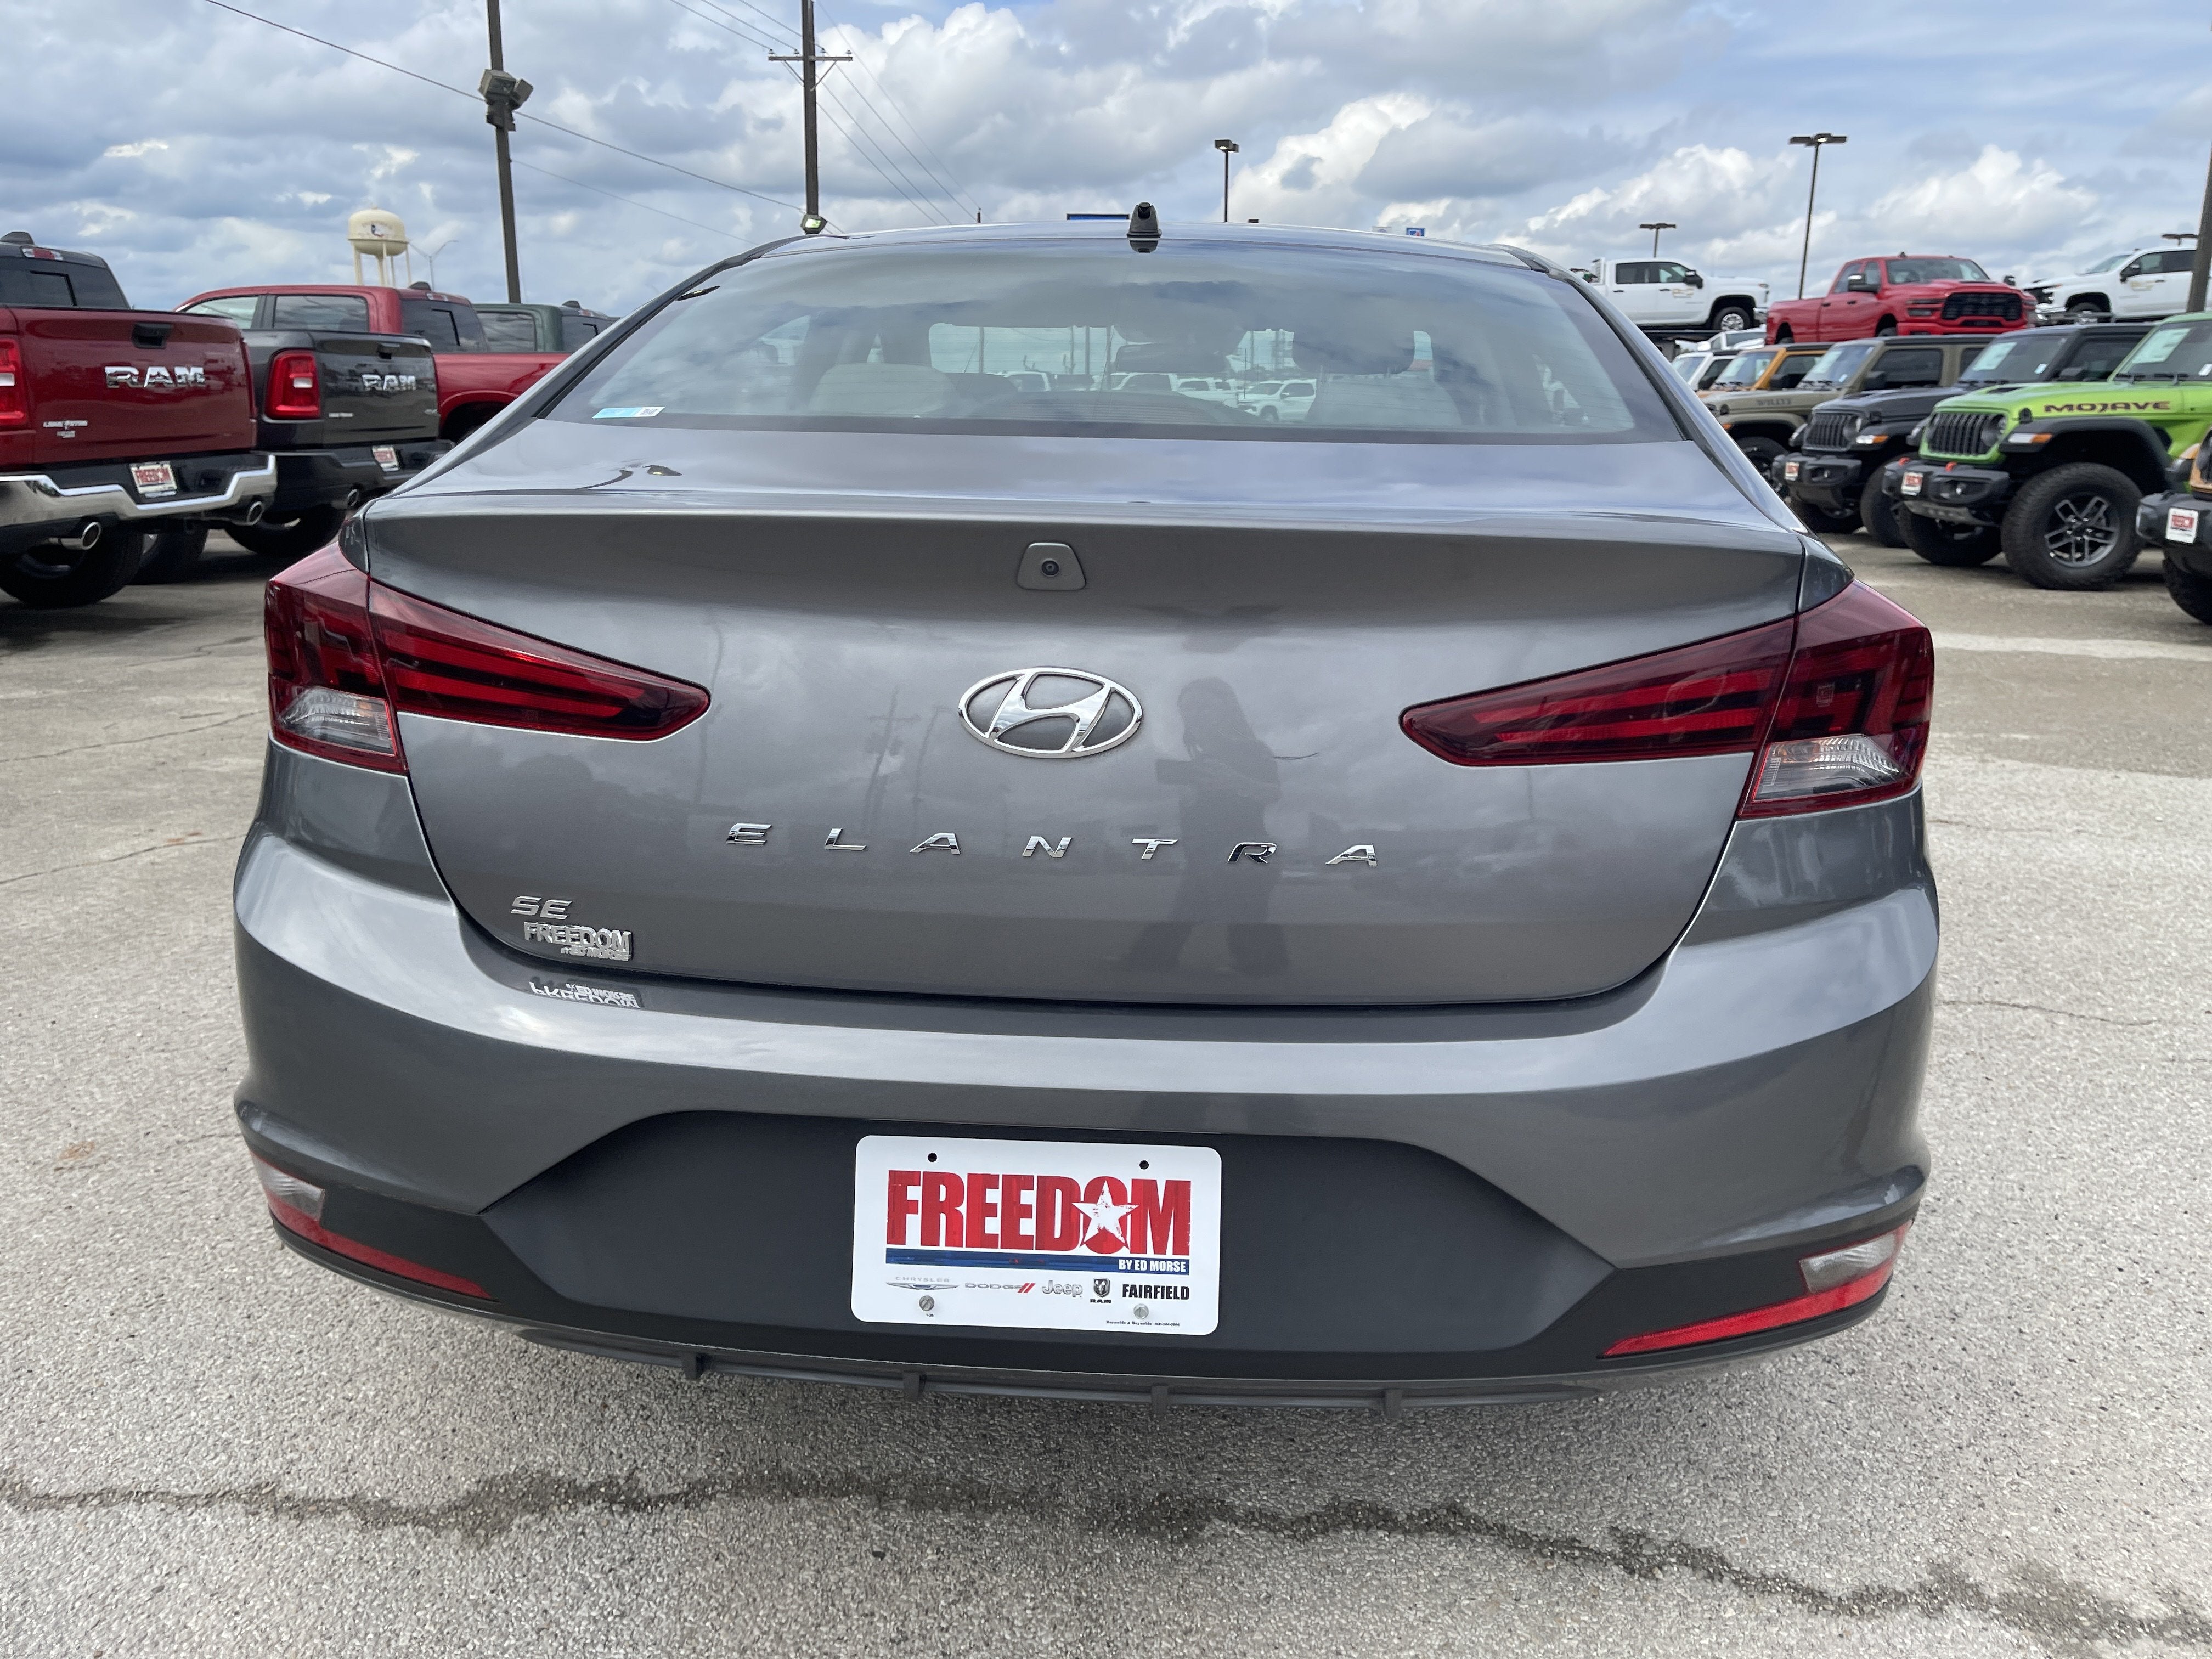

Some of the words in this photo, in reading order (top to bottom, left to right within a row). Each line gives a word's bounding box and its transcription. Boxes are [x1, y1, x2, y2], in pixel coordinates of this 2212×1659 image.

[104, 366, 205, 388] RAM
[362, 374, 416, 391] RAM
[2044, 401, 2170, 413] MOJAVE
[725, 822, 1379, 867] ELANTRA
[511, 896, 573, 920] SE
[524, 922, 632, 952] FREEDOM
[887, 1170, 1191, 1255] FREEDOM
[1119, 1259, 1133, 1271] BY
[1135, 1260, 1147, 1272] ED
[1149, 1260, 1186, 1272] MORSE
[1042, 1280, 1083, 1298] Jeep
[1122, 1284, 1190, 1300] FAIRFIELD
